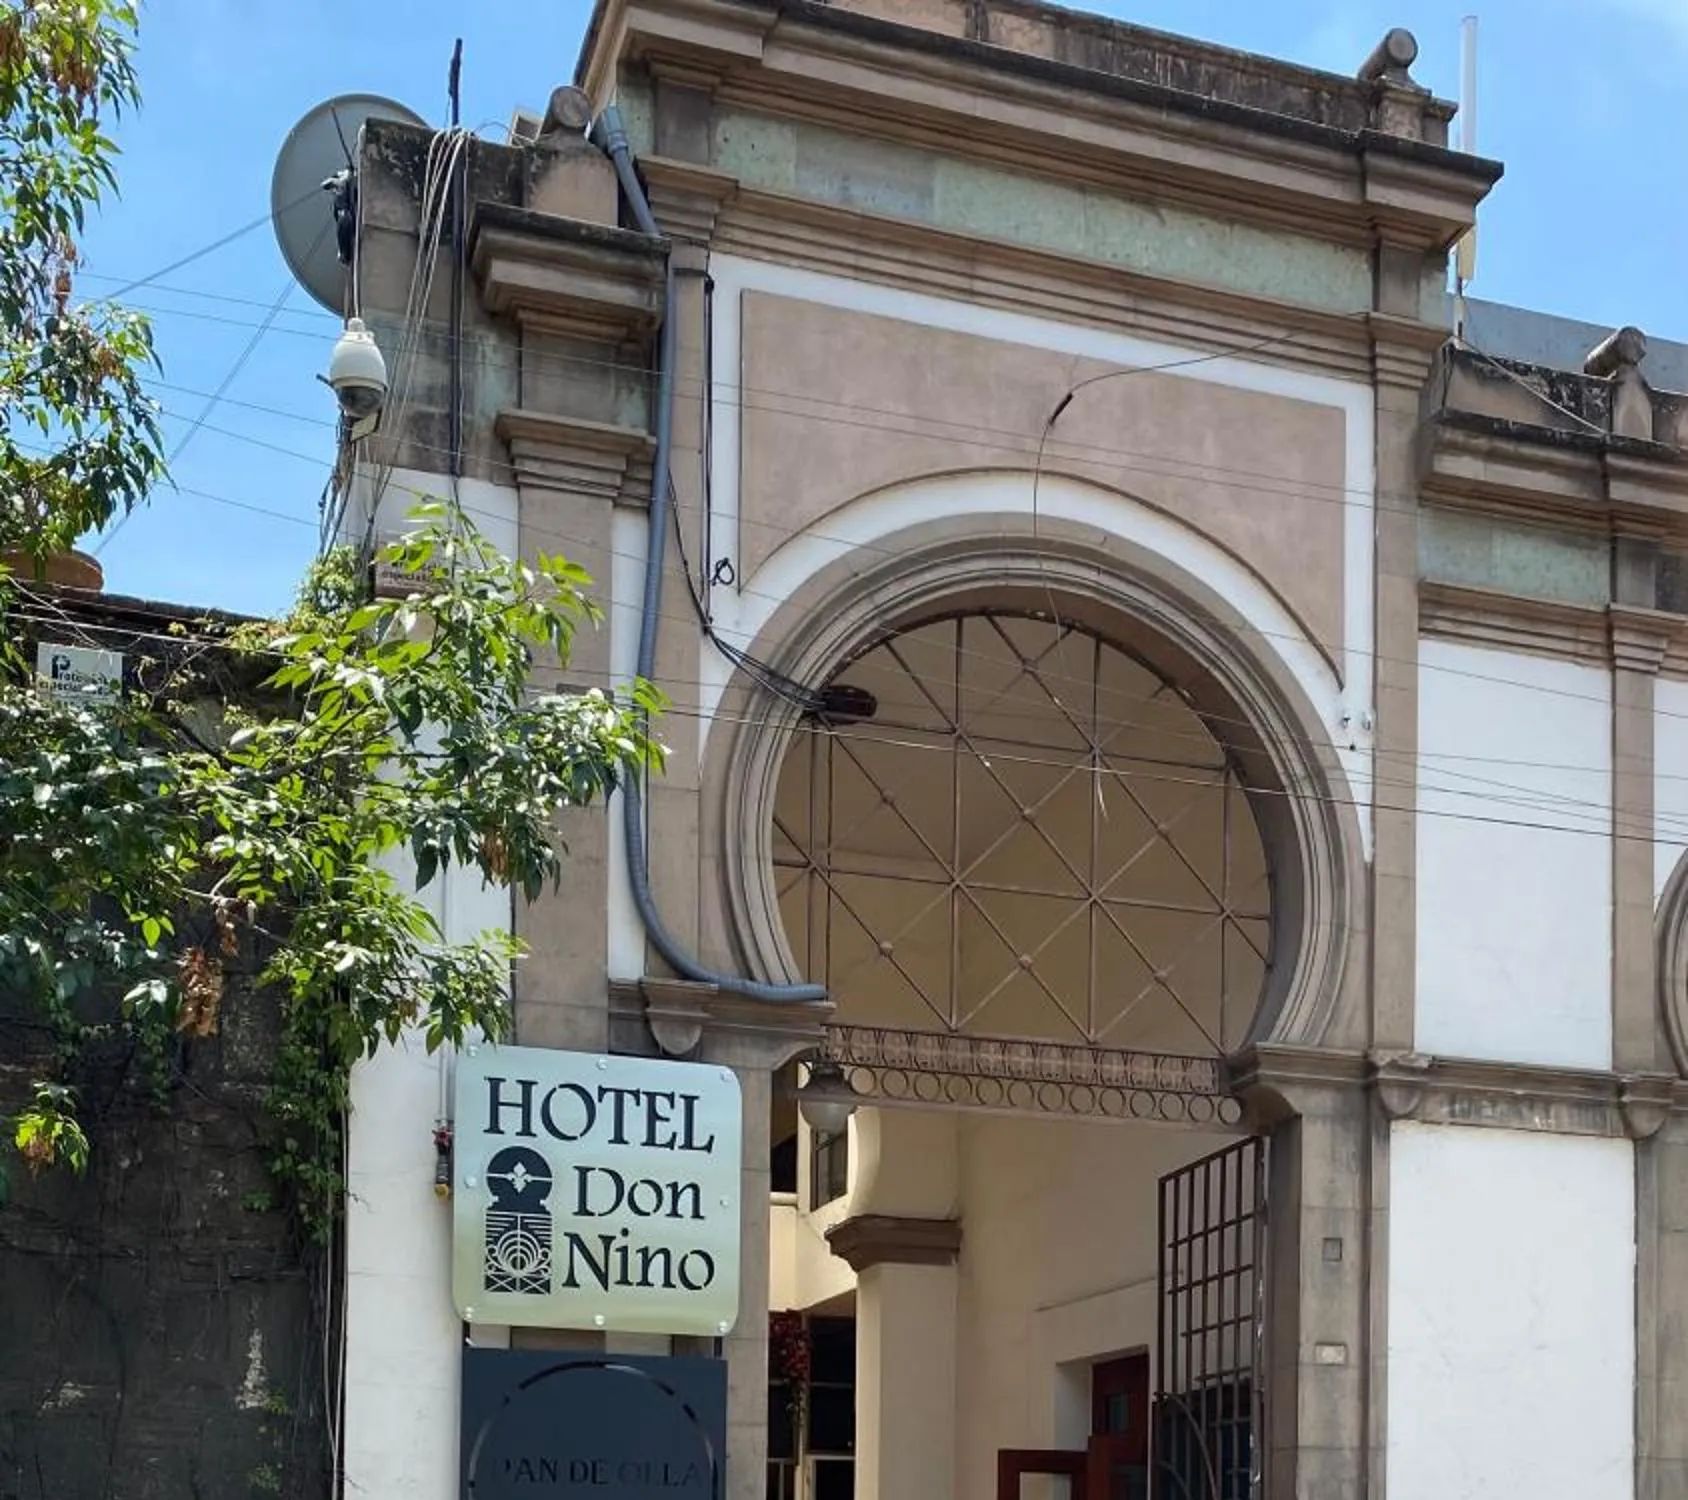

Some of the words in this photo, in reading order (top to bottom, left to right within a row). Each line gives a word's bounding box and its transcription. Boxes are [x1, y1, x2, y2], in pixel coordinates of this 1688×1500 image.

[483, 1077, 715, 1153] HOTEL
[572, 1165, 705, 1220] Don
[562, 1227, 715, 1293] Nino
[569, 1459, 609, 1486] DE
